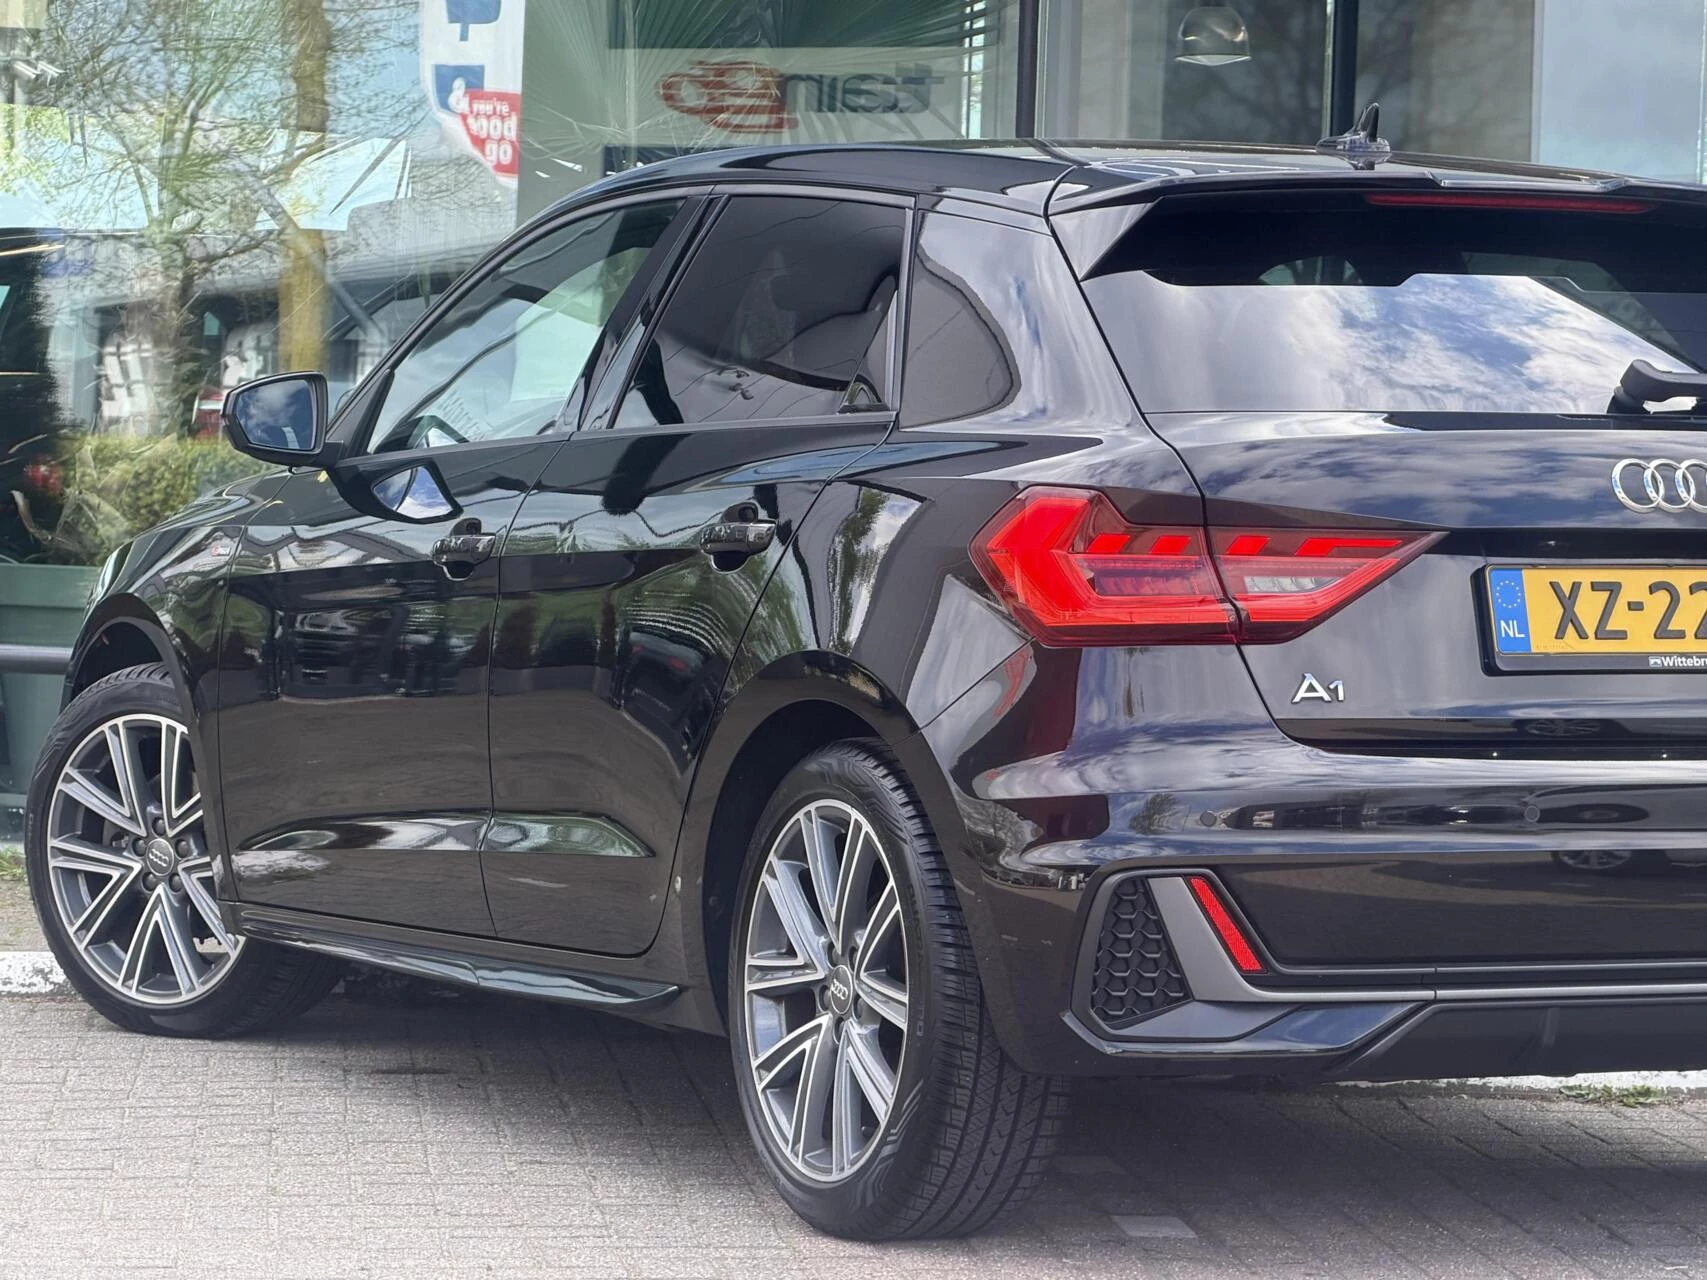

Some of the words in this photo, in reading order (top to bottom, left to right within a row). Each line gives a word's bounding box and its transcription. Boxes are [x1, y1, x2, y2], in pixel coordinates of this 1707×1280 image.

[473, 97, 509, 114] you're
[467, 113, 516, 140] good
[1500, 620, 1525, 638] NL
[1661, 655, 1707, 667] Wittebr
[1291, 672, 1345, 704] A1
